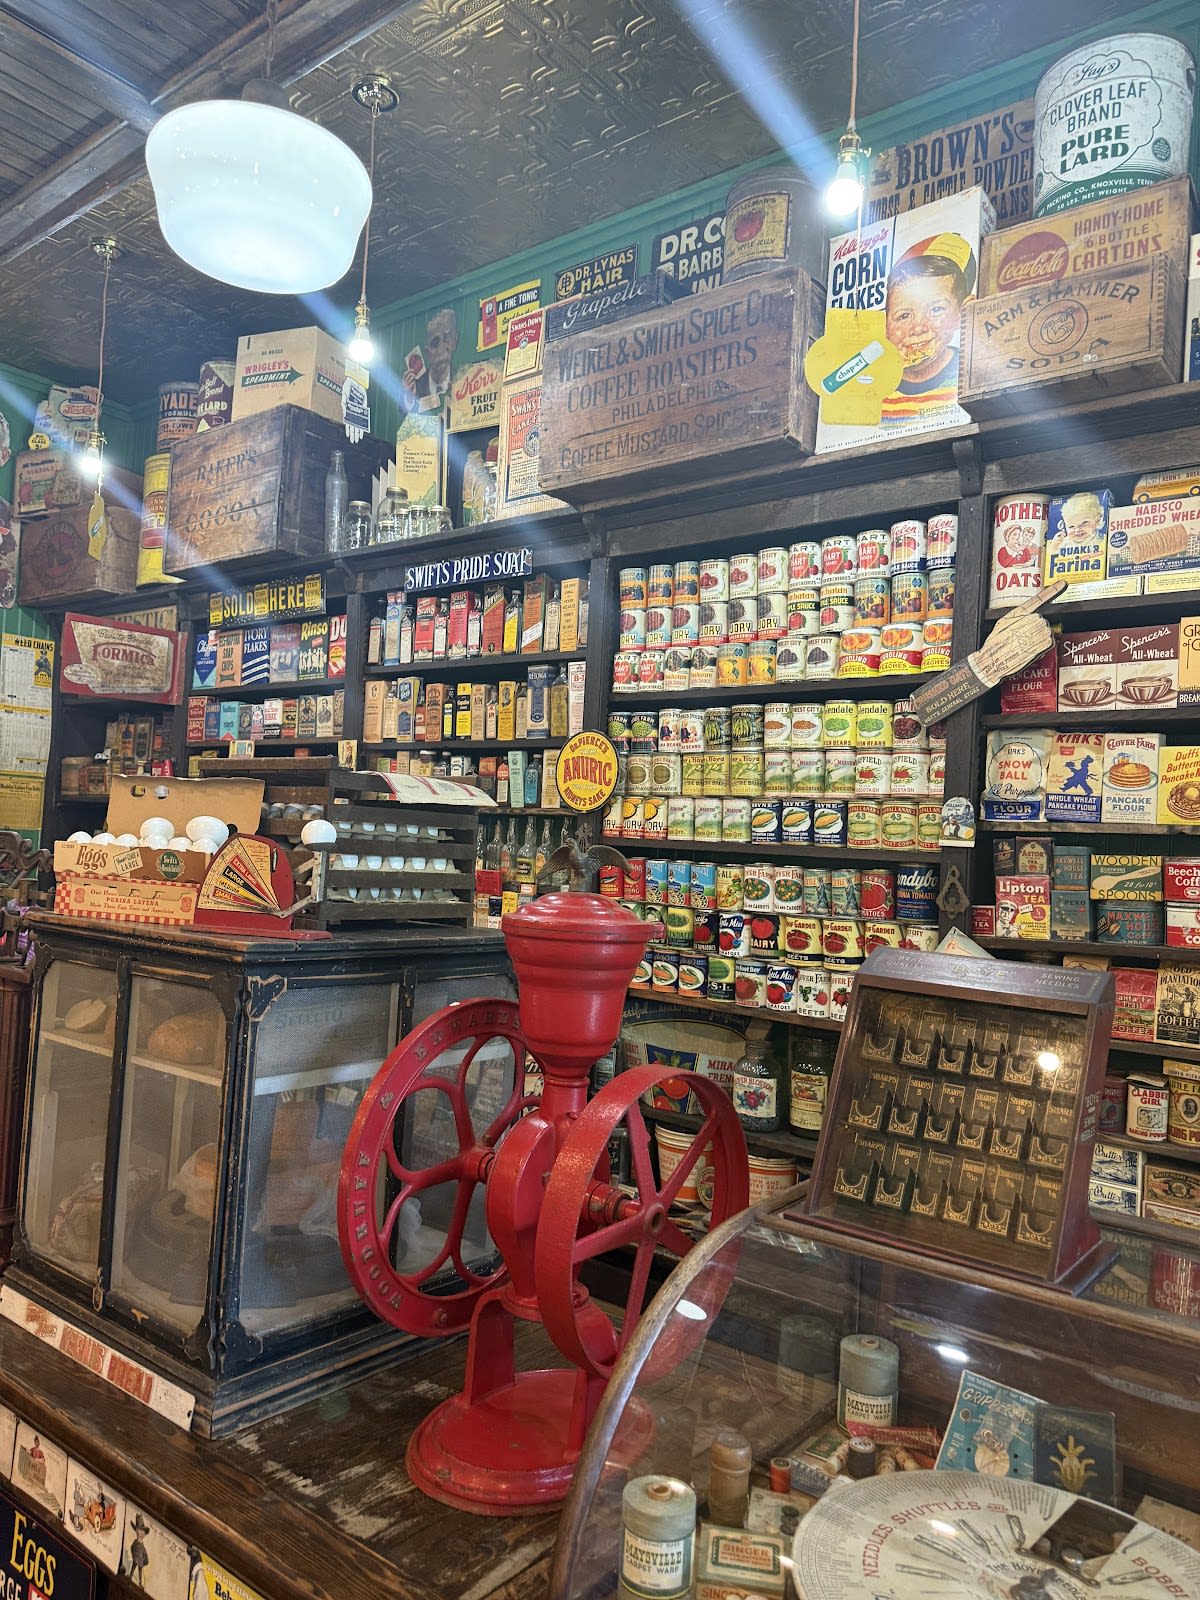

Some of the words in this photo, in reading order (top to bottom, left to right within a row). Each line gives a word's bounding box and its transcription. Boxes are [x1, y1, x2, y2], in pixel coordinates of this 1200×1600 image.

[1050, 87, 1102, 126] CLOVER
[1068, 101, 1121, 134] BRAND
[1061, 124, 1129, 157] PURE
[895, 111, 1014, 190] BROWN'S
[1060, 142, 1129, 174] LARD
[1098, 187, 1128, 197] WEIGHT
[1046, 190, 1072, 211] PACKING
[659, 225, 703, 263] DR.
[1072, 234, 1163, 273] CARTONS
[575, 265, 593, 282] DR.
[594, 249, 634, 273] LYNAS
[831, 245, 888, 297] CORN
[998, 246, 1069, 285] Coca-Cola
[581, 266, 623, 293] HAIR
[498, 304, 504, 313] A
[504, 297, 517, 311] FINE
[518, 289, 538, 305] TONIC
[563, 279, 648, 329] Grapette
[983, 304, 1025, 337] ARM
[1028, 292, 1043, 309] &
[1047, 279, 1140, 304] HAMMER
[510, 320, 527, 333] SWANS
[558, 345, 615, 383] WEIKEL
[617, 337, 631, 367] &
[632, 316, 685, 364] SMITH
[688, 299, 743, 346] SPICE
[1006, 337, 1111, 370] SODA
[244, 359, 290, 376] WRIGLEY'S
[567, 367, 640, 414] COFFEE
[645, 335, 758, 393] ROASTERS
[244, 371, 291, 386] SPEARMINT
[455, 366, 499, 401] Kerr
[470, 391, 499, 406] FRUIT
[612, 379, 731, 423] PHILADELPHIA
[472, 402, 496, 417] JARS
[511, 399, 536, 417] SWANS
[561, 440, 618, 470] COFFEE
[617, 421, 689, 455] MUSTARD
[1135, 500, 1183, 516] NABISCO
[1110, 514, 1167, 532] SHREDDED
[1059, 544, 1100, 557] QUAKER
[406, 559, 451, 590] SWIFT'S
[452, 553, 491, 583] PRIDE
[493, 547, 530, 577] SOAP
[1049, 553, 1101, 579] Farina
[996, 572, 1041, 592] OATS
[223, 592, 254, 619] SOLD
[269, 583, 304, 612] HERE
[797, 602, 816, 610] SAUCE
[829, 596, 849, 606] SAUCE
[244, 626, 269, 642] IVORY
[300, 621, 329, 641] Rinso
[243, 641, 269, 654] FLAKES
[1063, 631, 1111, 658] Spencer's
[1121, 626, 1172, 654] Spencer's
[92, 642, 158, 667] FORMICA
[223, 647, 234, 659] SOAP
[1072, 653, 1113, 665] All-Wheat
[1131, 648, 1175, 661] All-Wheat
[1011, 681, 1043, 692] FLOUR
[925, 696, 948, 714] SOLD
[947, 682, 970, 700] HERE
[1055, 733, 1104, 745] KIRK'S
[1106, 738, 1136, 751] CLOVER
[1136, 737, 1157, 751] FARM
[1175, 750, 1199, 762] Duff's
[563, 756, 613, 788] ANURIC
[998, 760, 1033, 771] SNOW
[999, 771, 1028, 781] BALL
[1160, 773, 1194, 785] Pancake
[588, 788, 607, 807] SAKE
[1048, 794, 1071, 804] WHOLE
[1073, 795, 1097, 804] WHEAT
[1105, 796, 1152, 806] PANCAKE
[993, 803, 1032, 815] FLOUR
[1047, 802, 1075, 811] PANCAKE
[1075, 803, 1097, 812] FLOUR
[1111, 803, 1146, 812] FLOUR
[855, 812, 867, 821] 43
[890, 812, 902, 821] 43
[76, 845, 109, 871] Eggs
[1021, 849, 1044, 858] ASTOR
[1093, 855, 1159, 866] WOODEN
[120, 860, 140, 871] LARGE
[1063, 864, 1084, 873] HOUSE
[224, 868, 245, 886] LARGE
[1069, 871, 1084, 880] TEA
[213, 889, 234, 901] SMALL
[999, 881, 1044, 895] Lipton
[1097, 890, 1157, 901] SPOONS
[106, 896, 131, 906] PURINA
[1023, 895, 1045, 904] TEA
[795, 919, 816, 930] GARDEN
[830, 922, 853, 933] GARDEN
[781, 970, 795, 982] Miss
[1041, 973, 1081, 983] SEWING
[798, 1007, 826, 1017] BEETS
[1112, 1024, 1151, 1035] COFFEE
[1139, 1097, 1161, 1106] GIRL
[847, 1396, 893, 1416] MAYSVILLE
[847, 1409, 871, 1419] CARPET
[873, 1412, 890, 1422] WARP
[891, 1500, 982, 1525] SHUTTLES
[9, 1510, 58, 1597] EGGS
[624, 1538, 682, 1566] MAYSVILLE
[723, 1542, 771, 1557] SINGER
[625, 1555, 653, 1574] CARPET
[656, 1564, 680, 1575] WARP
